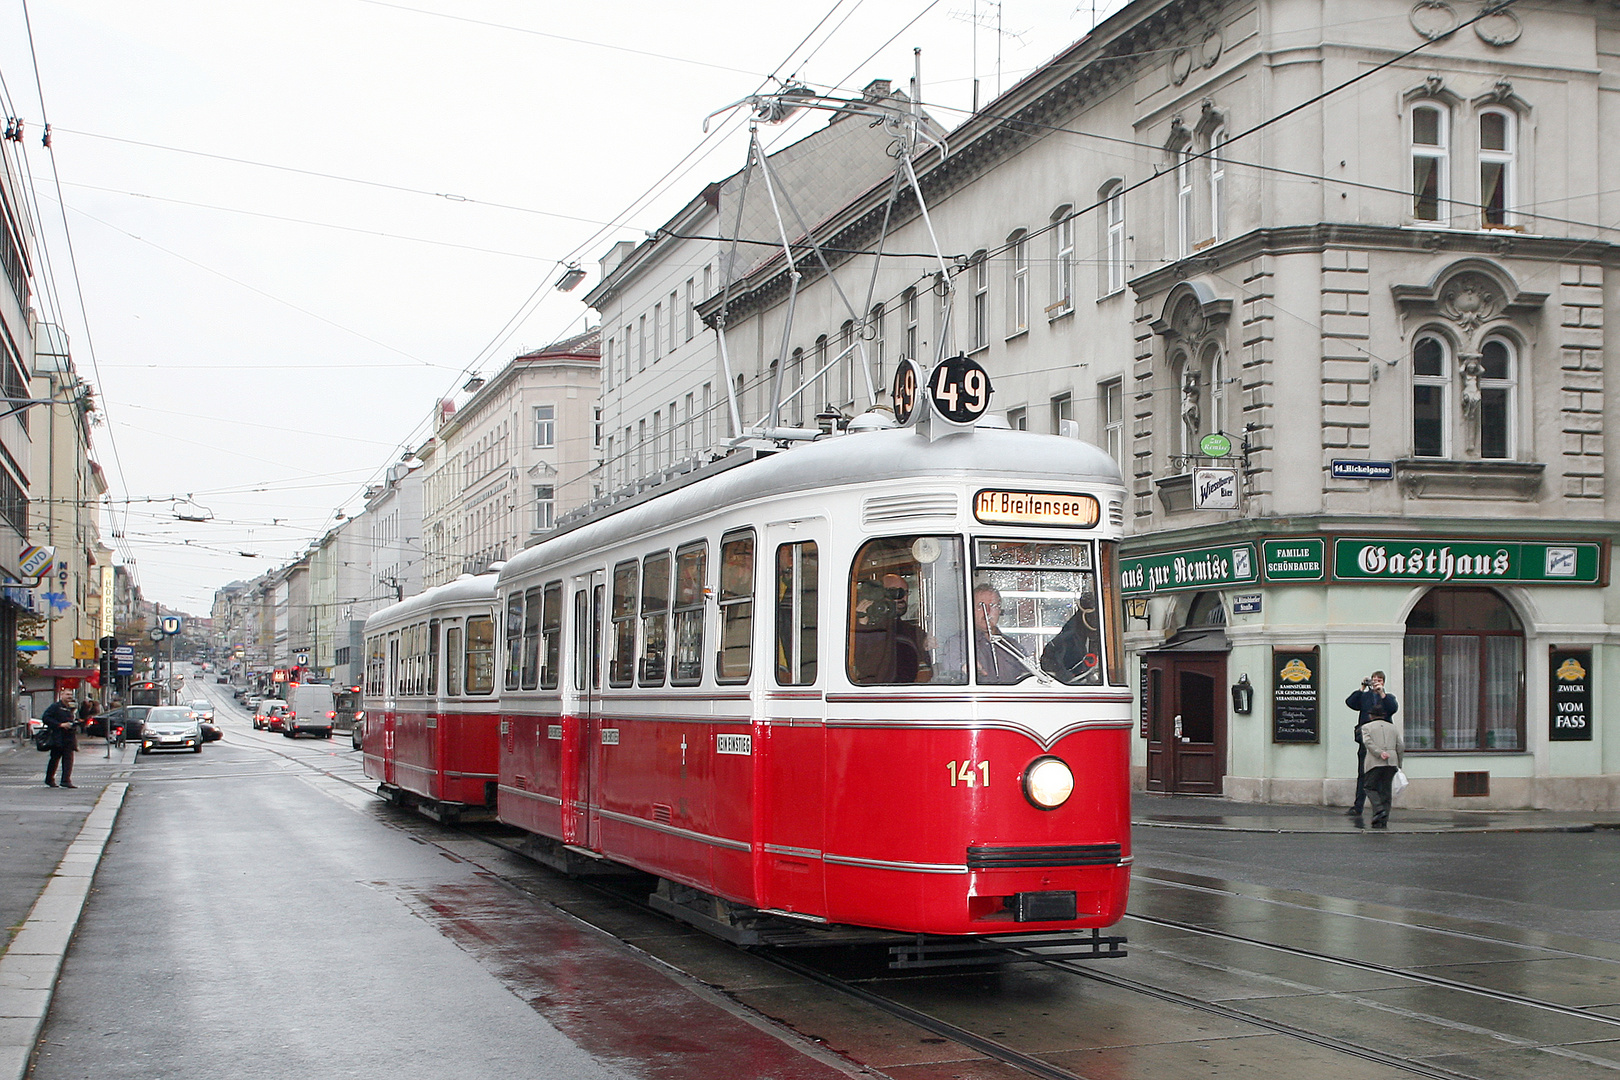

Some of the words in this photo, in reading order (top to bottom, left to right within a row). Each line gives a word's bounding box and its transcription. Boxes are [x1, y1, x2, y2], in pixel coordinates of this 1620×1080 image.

[894, 369, 915, 415] 49
[936, 366, 986, 413] 49
[1001, 493, 1080, 516] Breitensee
[23, 551, 47, 573] DVD
[1277, 549, 1310, 558] FAMILIE
[1358, 545, 1511, 582] Gasthaus
[1149, 565, 1170, 593] zur
[1174, 553, 1229, 583] Remise
[1268, 561, 1320, 571] SCHÖNBAUER
[165, 619, 178, 632] U
[1558, 702, 1584, 712] VOM
[1556, 715, 1586, 728] FASS
[946, 760, 990, 787] 141
